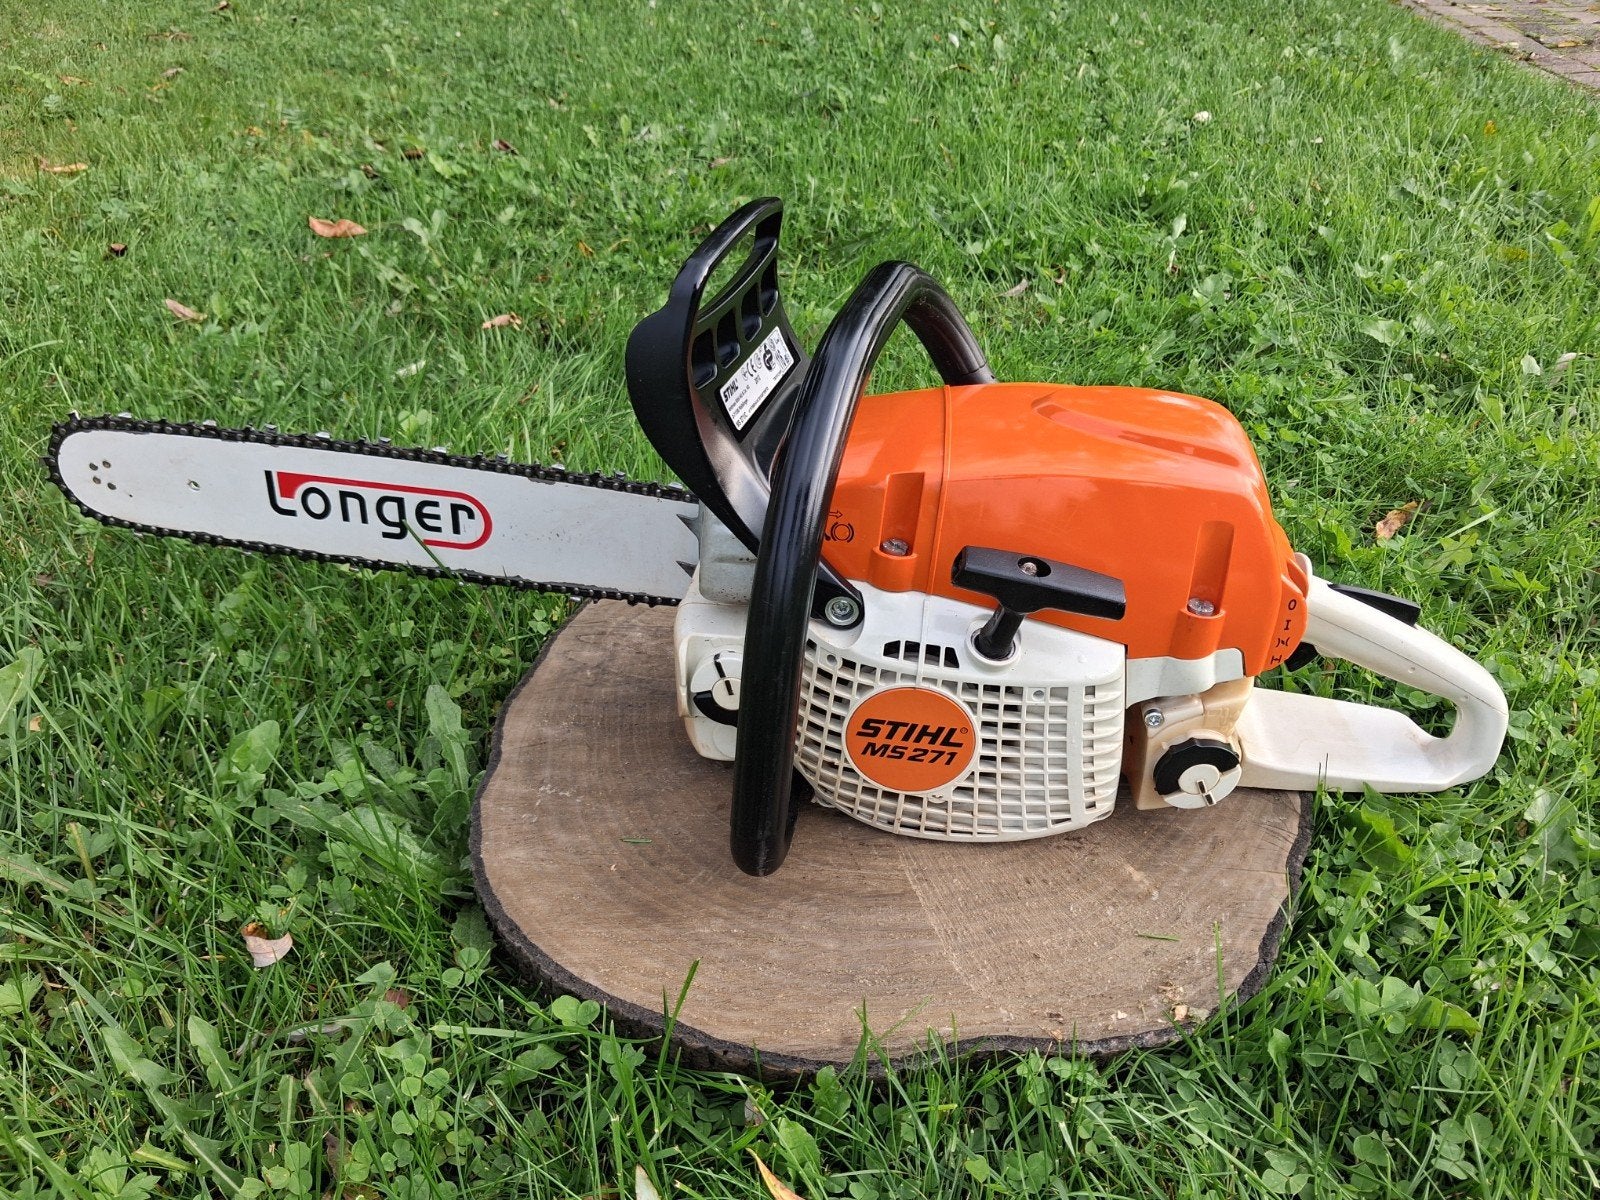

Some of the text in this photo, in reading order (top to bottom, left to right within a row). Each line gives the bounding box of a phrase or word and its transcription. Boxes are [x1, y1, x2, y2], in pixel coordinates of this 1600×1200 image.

[723, 380, 739, 403] STIHL
[264, 469, 476, 540] Longer
[856, 718, 964, 748] STIHL
[861, 741, 958, 766] MS 271
